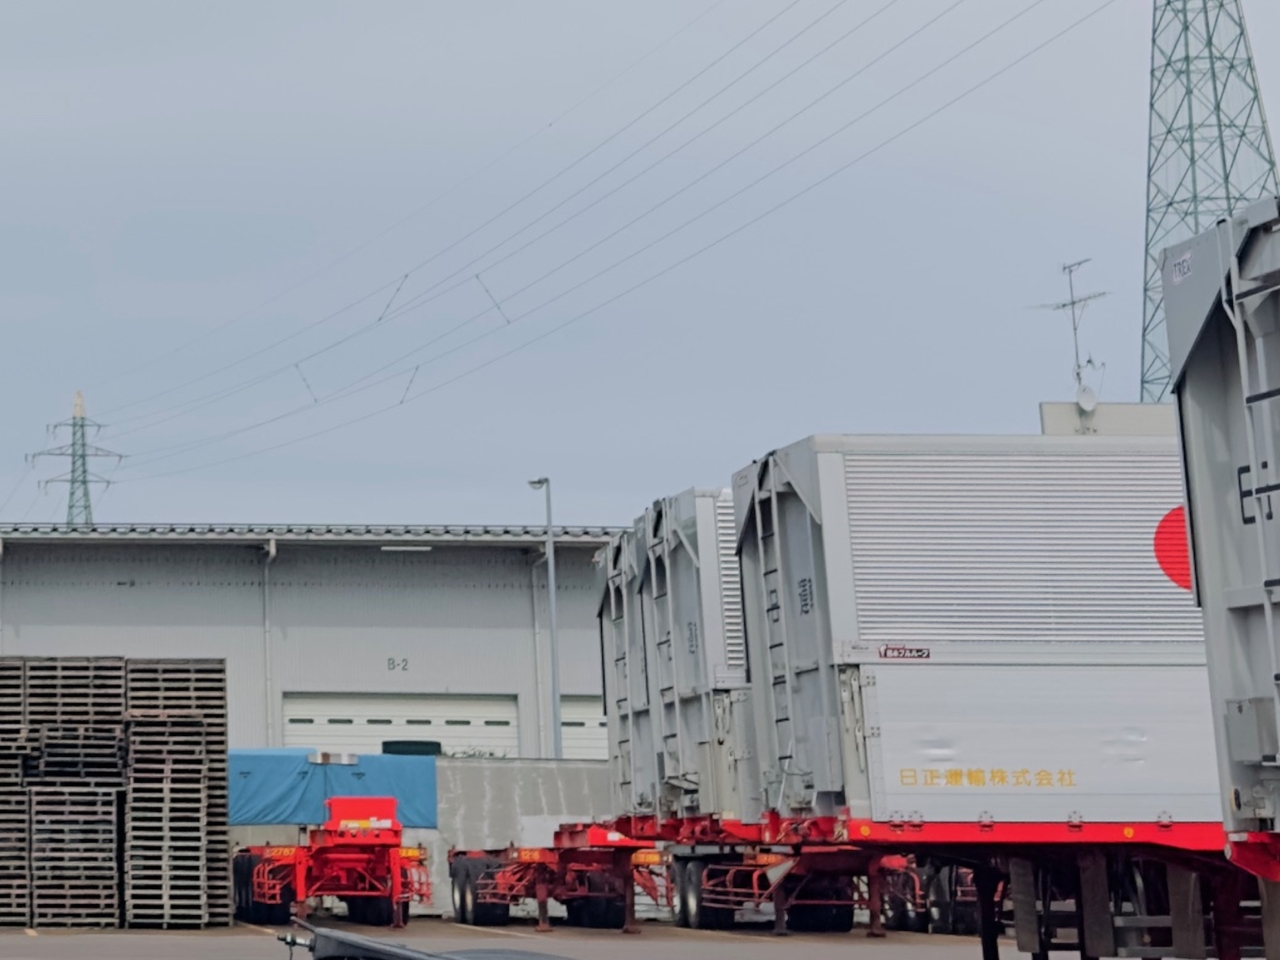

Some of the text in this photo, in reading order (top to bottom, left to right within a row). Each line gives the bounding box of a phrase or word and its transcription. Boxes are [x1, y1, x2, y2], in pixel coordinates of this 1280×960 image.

[387, 658, 408, 671] B-2
[899, 768, 1076, 787] 日正運輸株式会社
